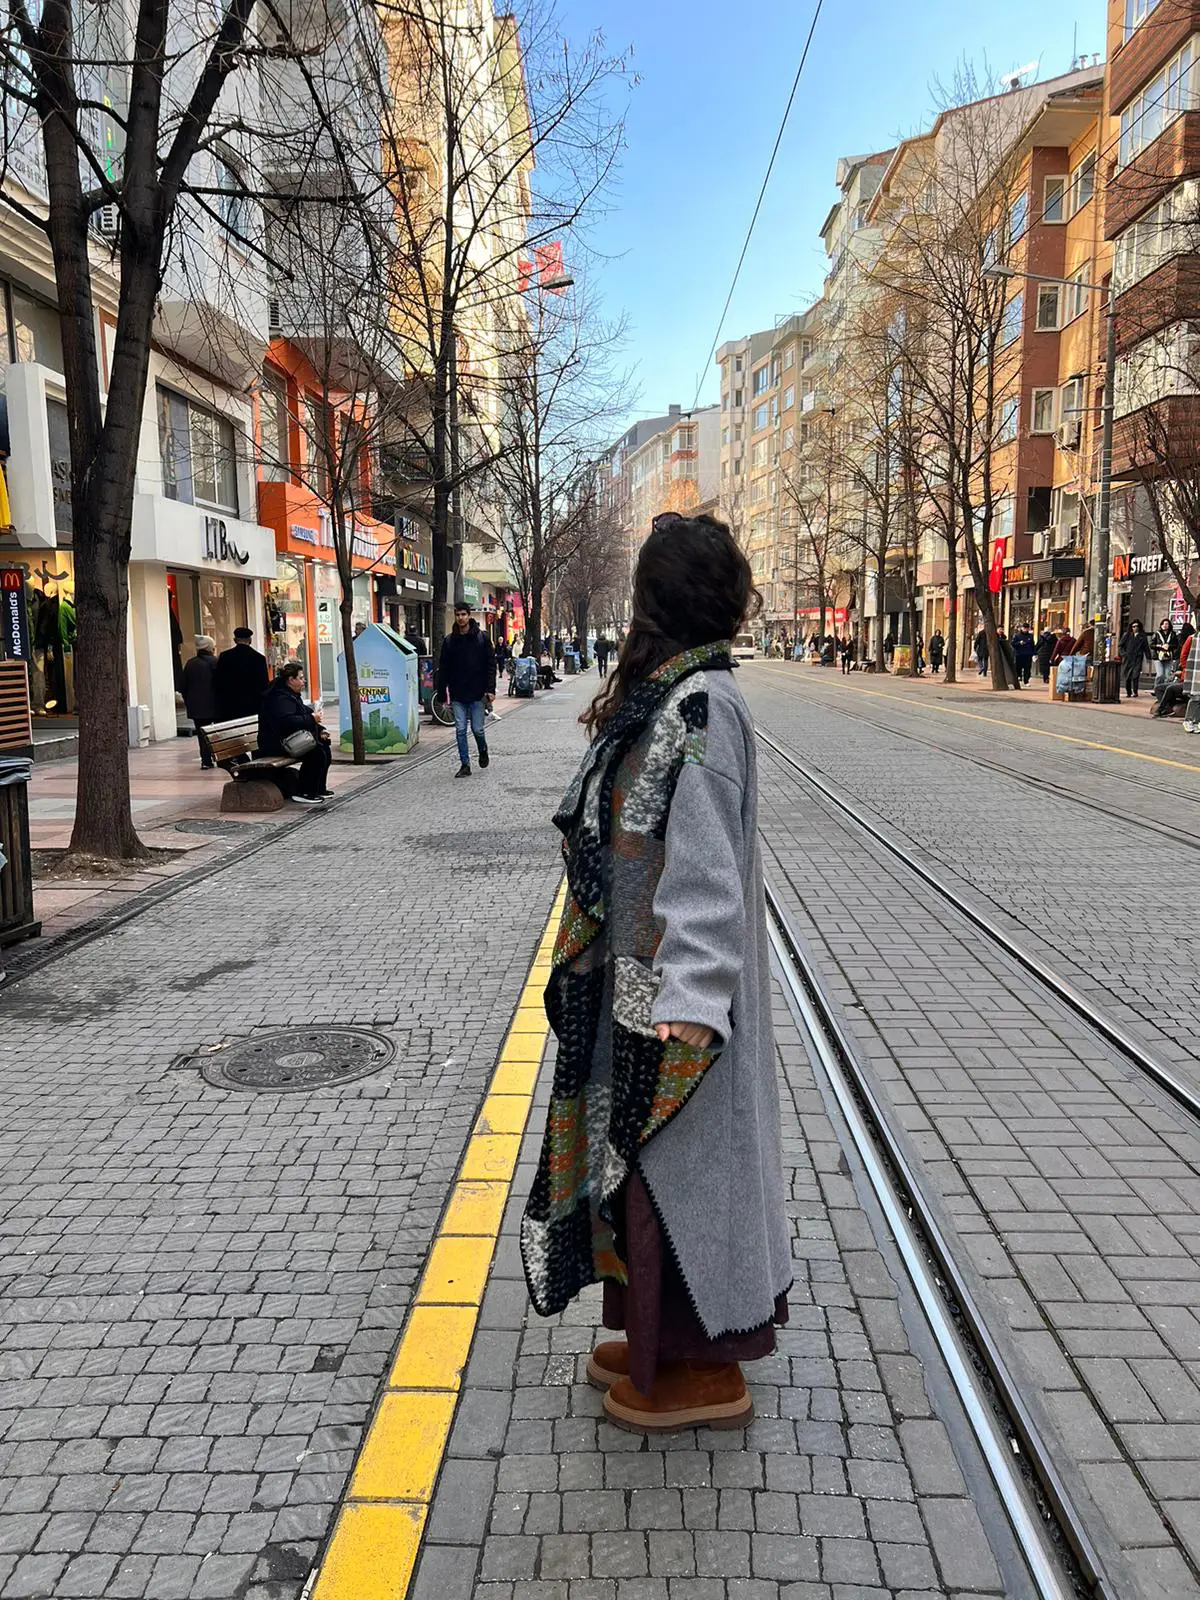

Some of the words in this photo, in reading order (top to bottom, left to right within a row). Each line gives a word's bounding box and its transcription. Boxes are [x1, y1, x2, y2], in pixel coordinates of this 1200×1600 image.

[200, 515, 229, 561] LTB
[1130, 553, 1164, 575] STREET
[9, 591, 22, 656] McDonald's
